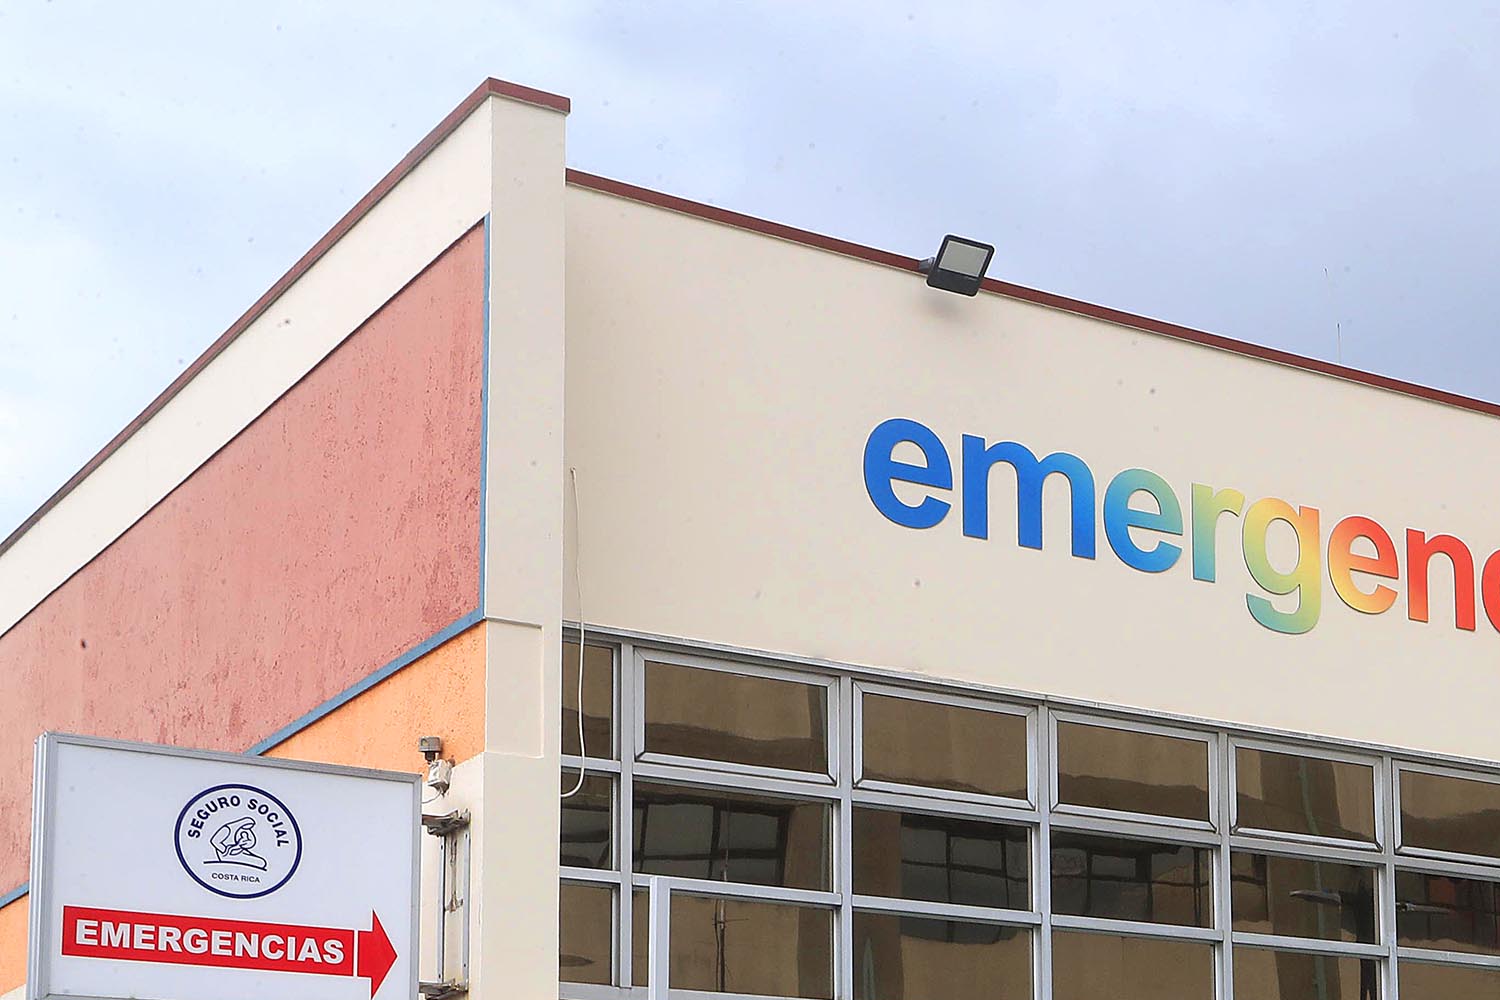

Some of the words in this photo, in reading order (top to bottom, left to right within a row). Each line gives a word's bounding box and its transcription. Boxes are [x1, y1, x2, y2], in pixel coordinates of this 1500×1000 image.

[187, 795, 241, 839] SEGURO
[247, 798, 289, 848] SOCIAL
[211, 872, 239, 881] COSTA
[241, 875, 260, 883] RICA
[75, 918, 344, 965] EMERGENCIAS
